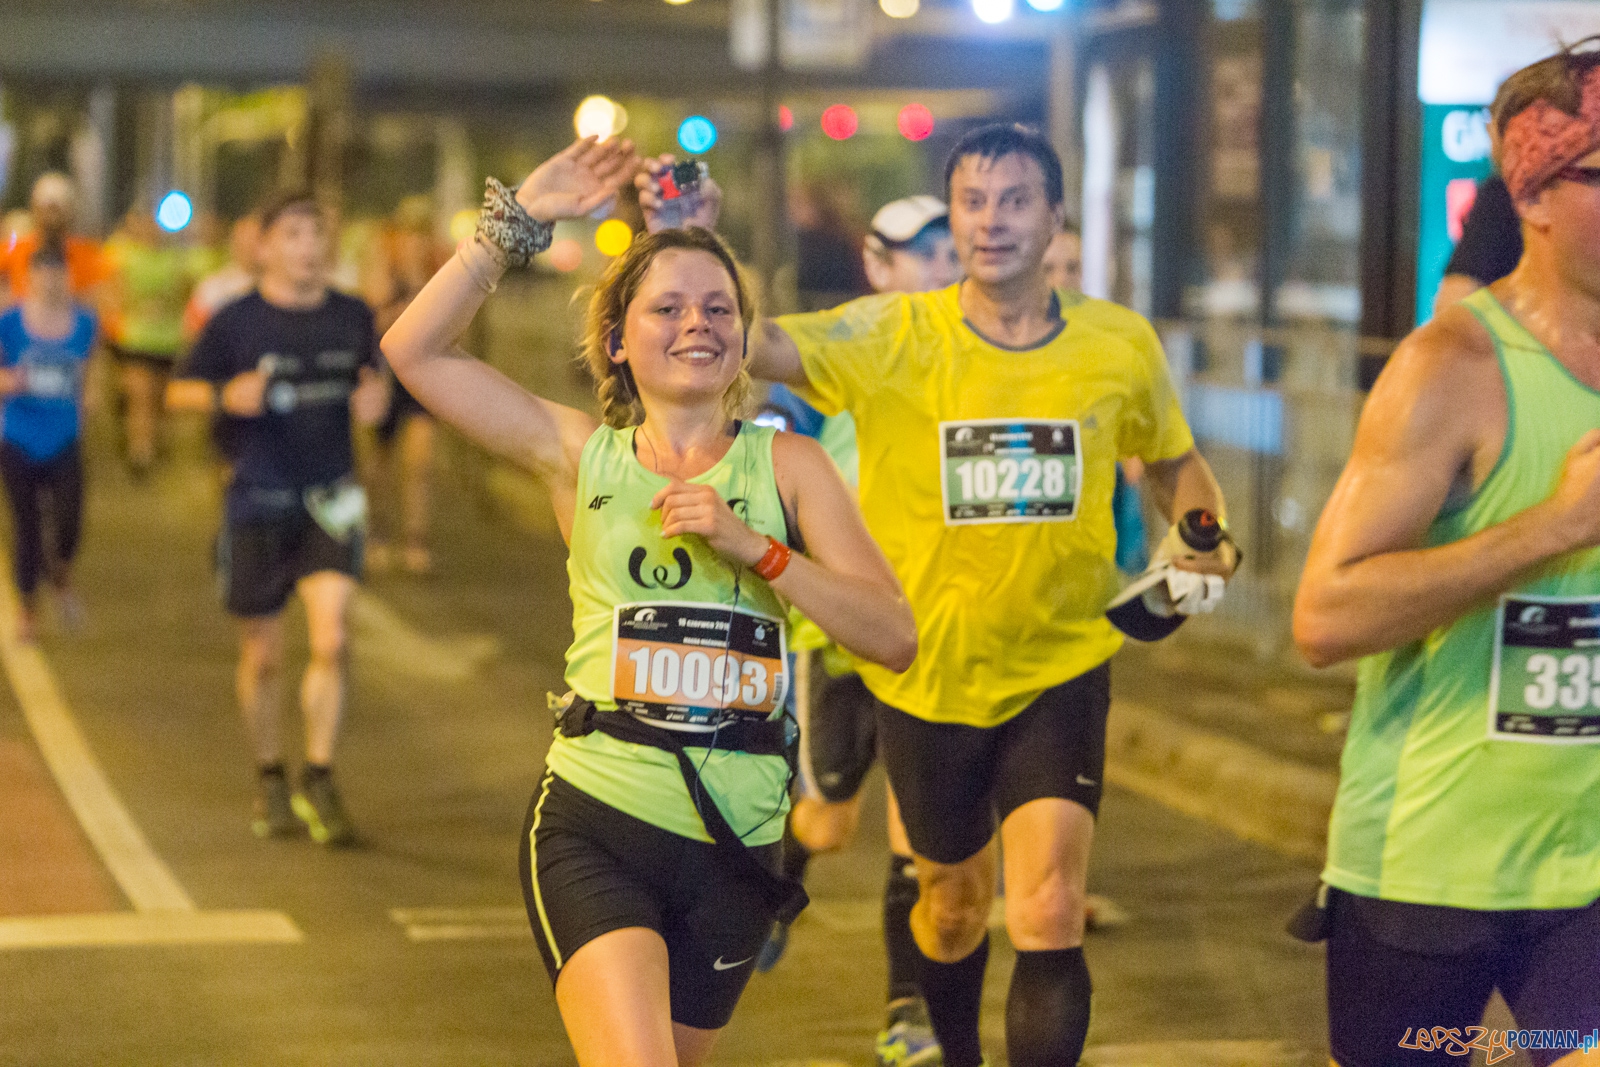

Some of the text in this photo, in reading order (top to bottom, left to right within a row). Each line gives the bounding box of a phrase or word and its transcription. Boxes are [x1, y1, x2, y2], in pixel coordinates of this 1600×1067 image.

[955, 457, 1066, 502] 10228
[629, 646, 768, 706] 10093
[1524, 653, 1600, 710] 33
